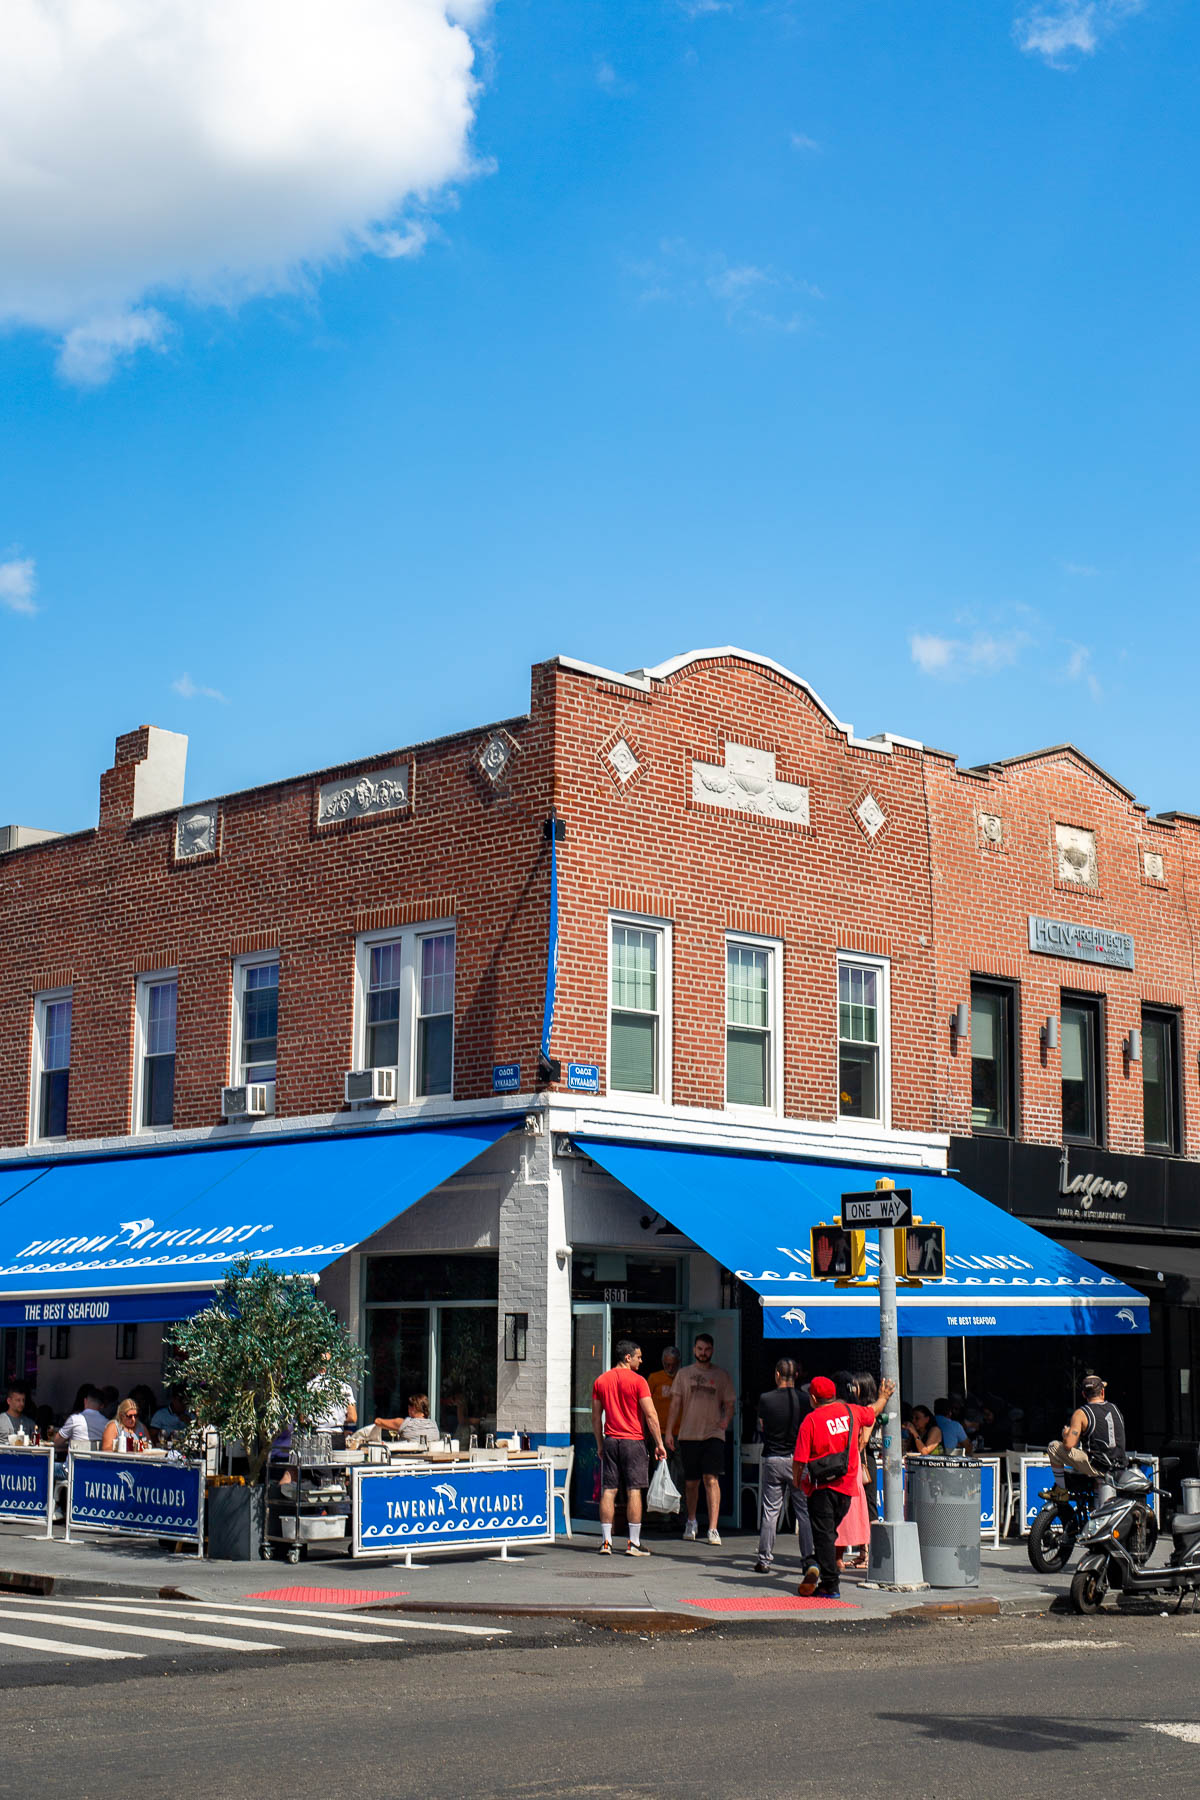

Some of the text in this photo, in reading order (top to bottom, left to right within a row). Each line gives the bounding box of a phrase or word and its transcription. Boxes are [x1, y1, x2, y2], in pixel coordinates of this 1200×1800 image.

[1035, 919, 1070, 946] HCN
[1071, 928, 1131, 950] ARCHITECTS
[851, 1202, 901, 1218] ONE WAY
[16, 1224, 263, 1258] TAVERNA KYCLADES
[947, 1254, 1035, 1270] CLADES
[604, 1289, 627, 1302] 3601
[24, 1301, 110, 1321] THE BEST SEAFOOD
[946, 1316, 997, 1326] THE BEST SEAFOOD
[826, 1415, 850, 1436] CAT
[0, 1474, 37, 1492] YCLADES
[84, 1480, 186, 1508] TAVERNA KYCLADES
[386, 1494, 524, 1520] TAVERNA KYCLADES
